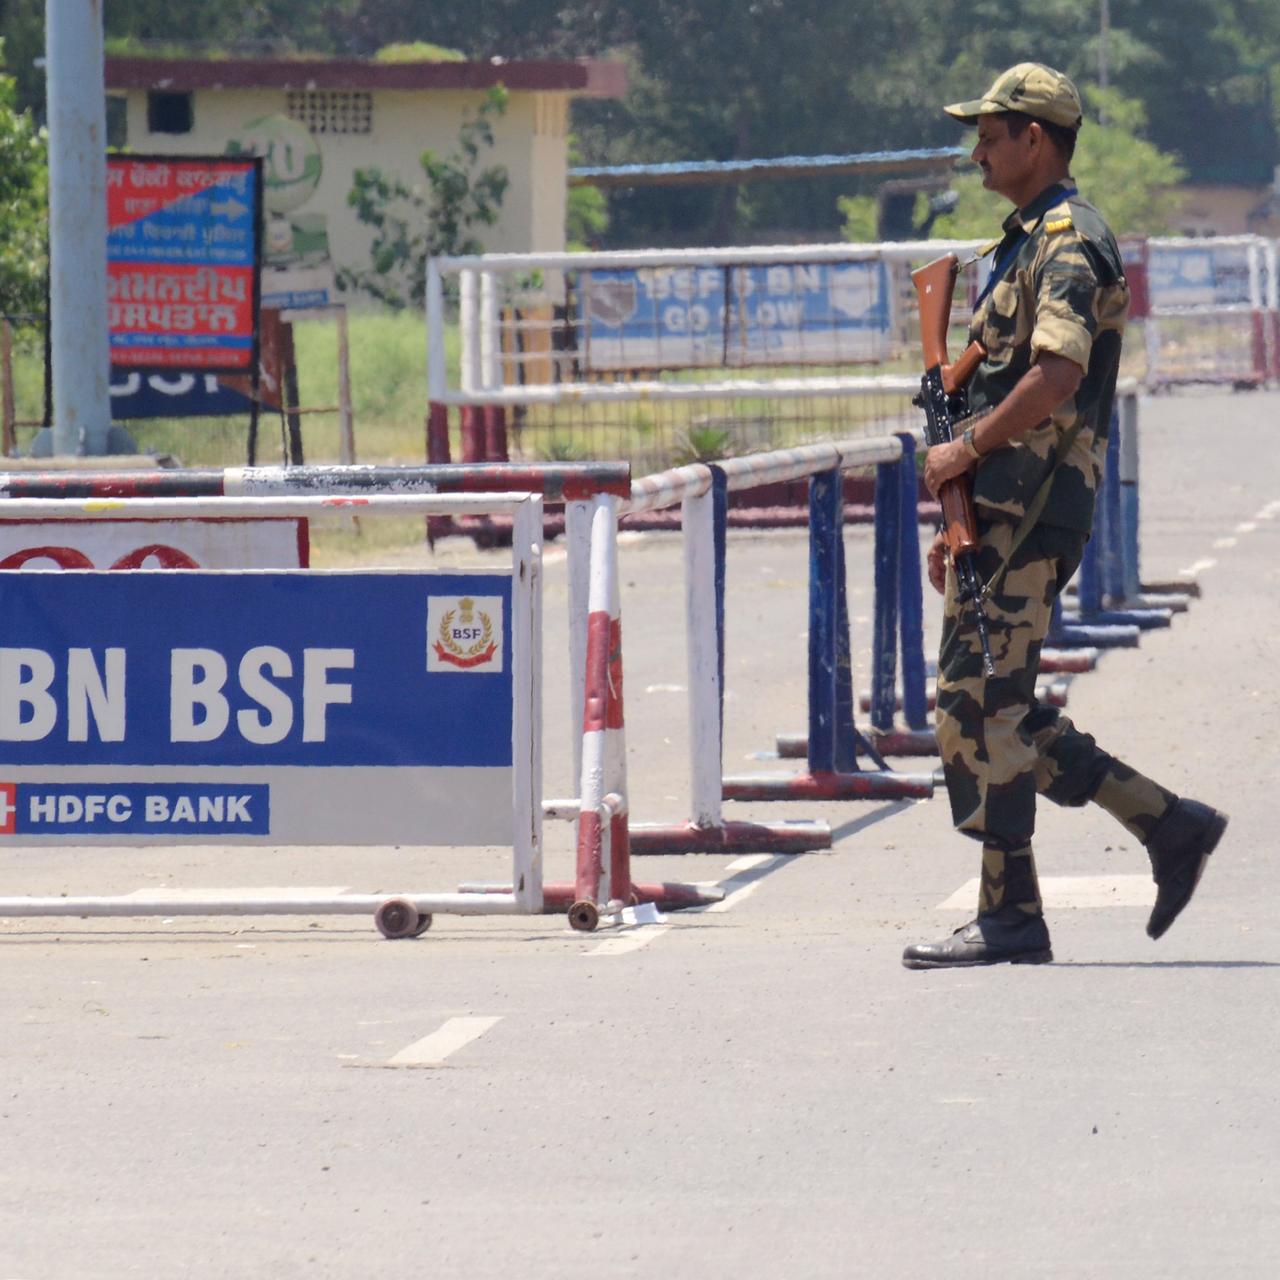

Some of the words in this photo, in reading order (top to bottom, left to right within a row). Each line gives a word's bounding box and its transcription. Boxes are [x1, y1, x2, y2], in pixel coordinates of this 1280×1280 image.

[453, 628, 481, 640] BSF
[0, 647, 126, 742] BN
[170, 645, 355, 745] BSF
[30, 795, 132, 823] HDFC
[145, 795, 252, 823] BANK
